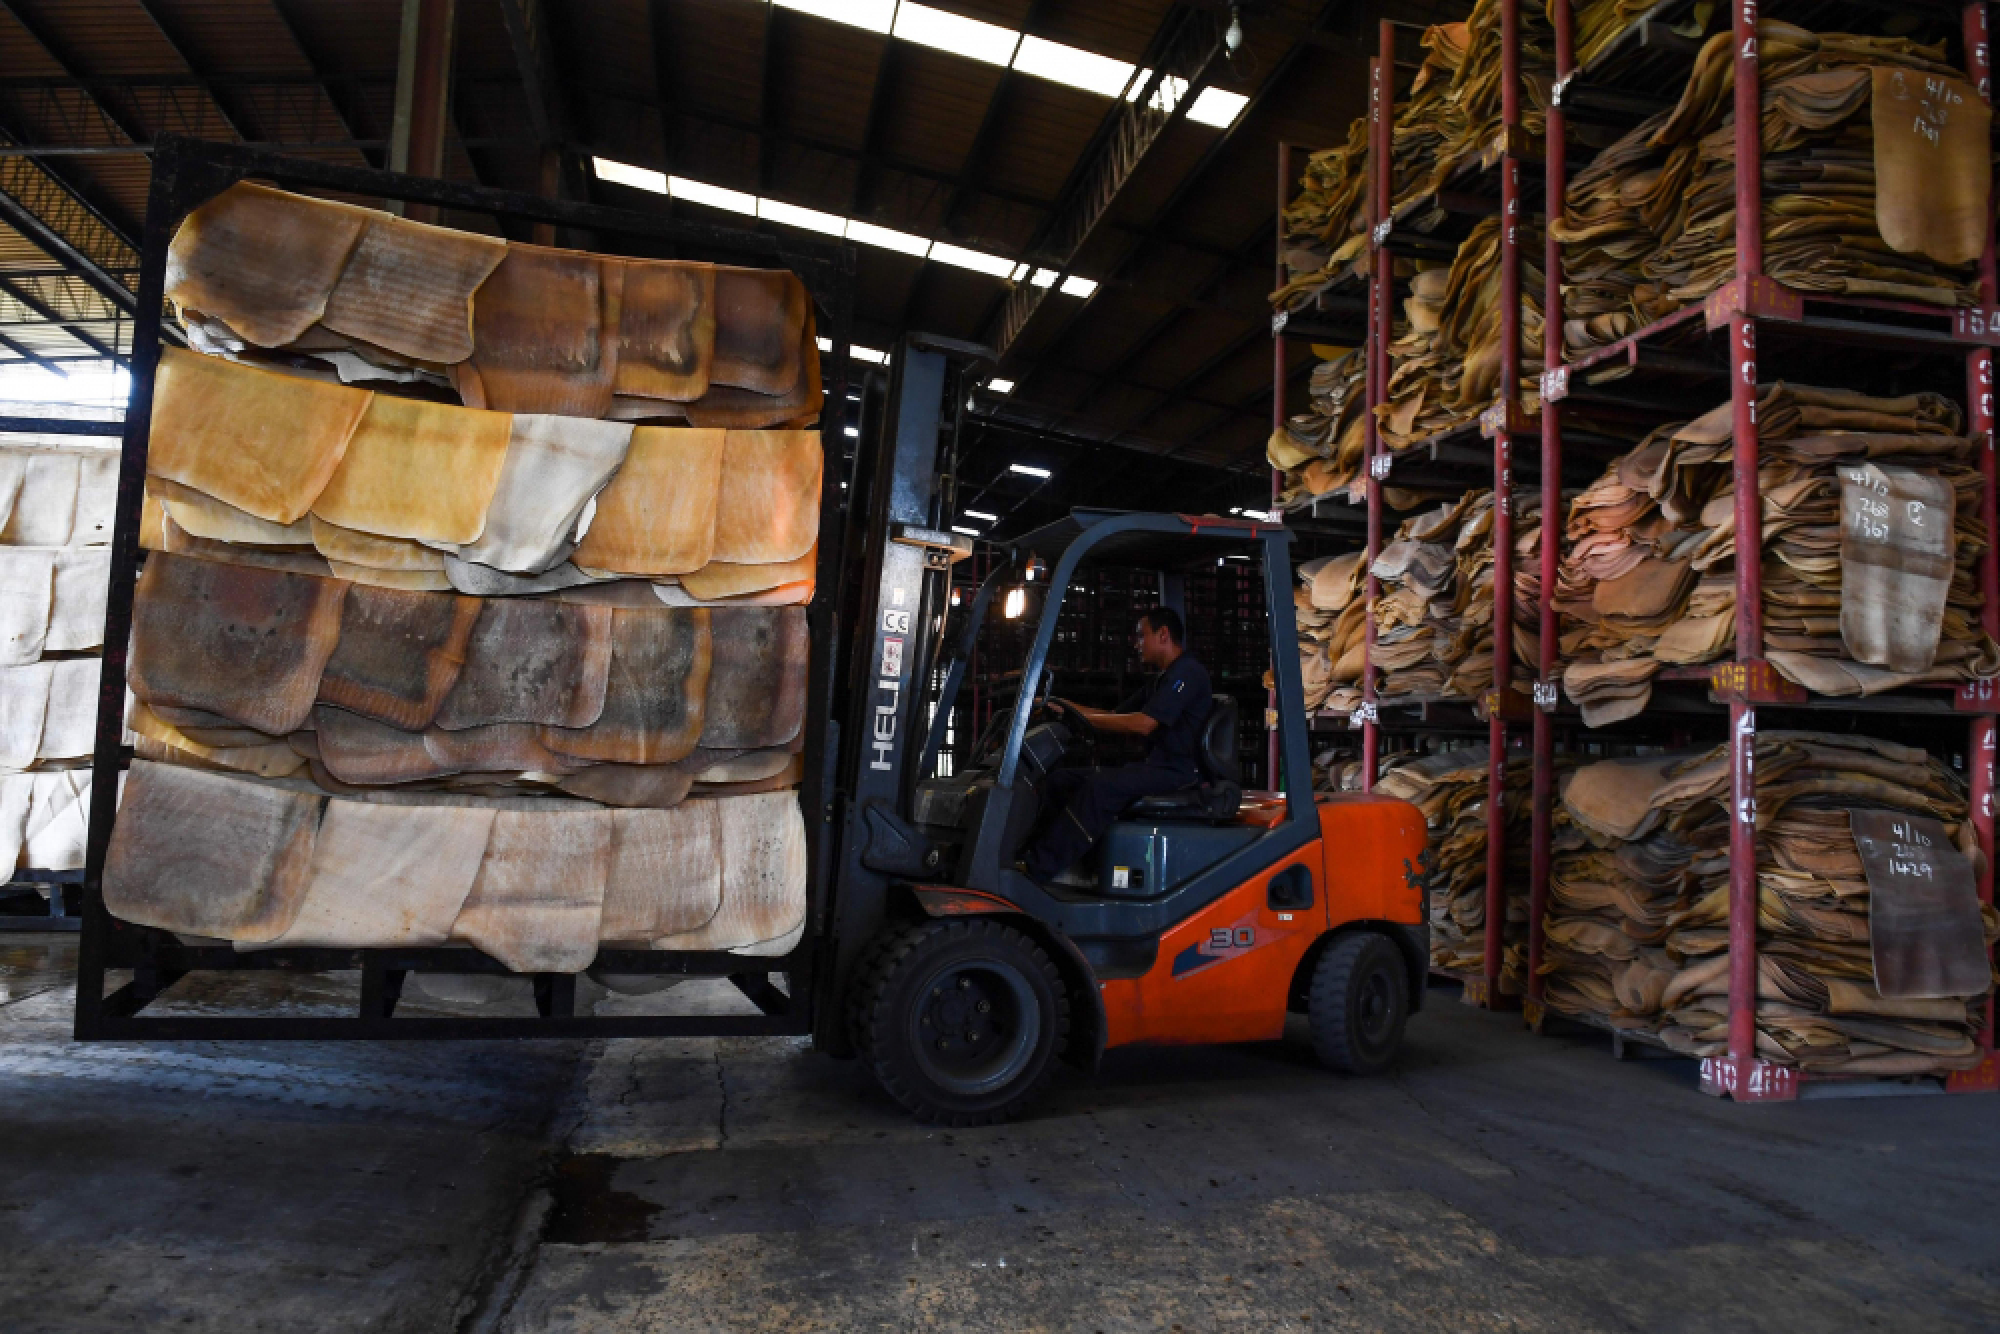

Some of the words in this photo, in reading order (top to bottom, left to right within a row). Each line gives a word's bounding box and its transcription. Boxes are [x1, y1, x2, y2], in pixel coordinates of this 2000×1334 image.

[870, 680, 900, 771] HELI
[1889, 859, 1933, 882] 1429
[1210, 928, 1255, 948] 30
